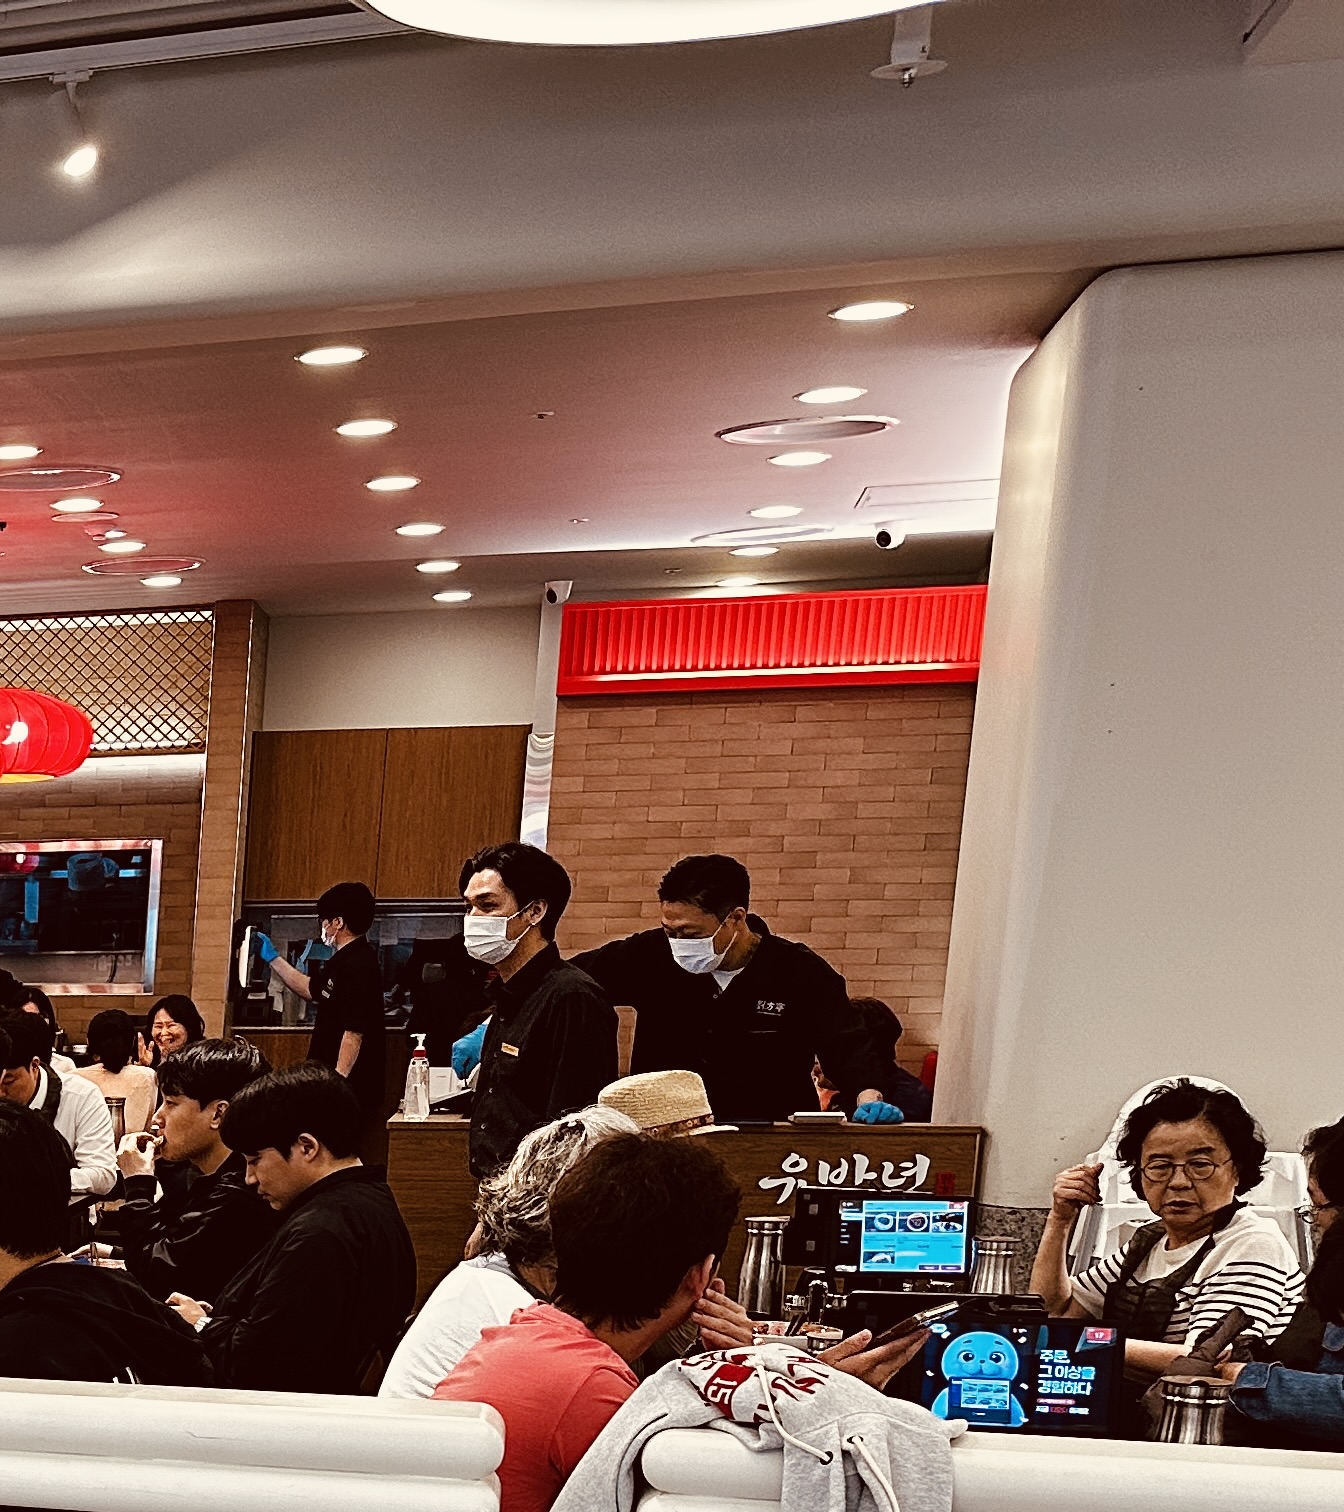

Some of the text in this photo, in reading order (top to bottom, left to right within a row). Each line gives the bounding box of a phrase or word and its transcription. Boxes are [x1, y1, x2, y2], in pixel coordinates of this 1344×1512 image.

[1038, 1364, 1096, 1380] 그 이상을
[707, 1376, 738, 1405] 15
[1037, 1380, 1093, 1396] 경험하다
